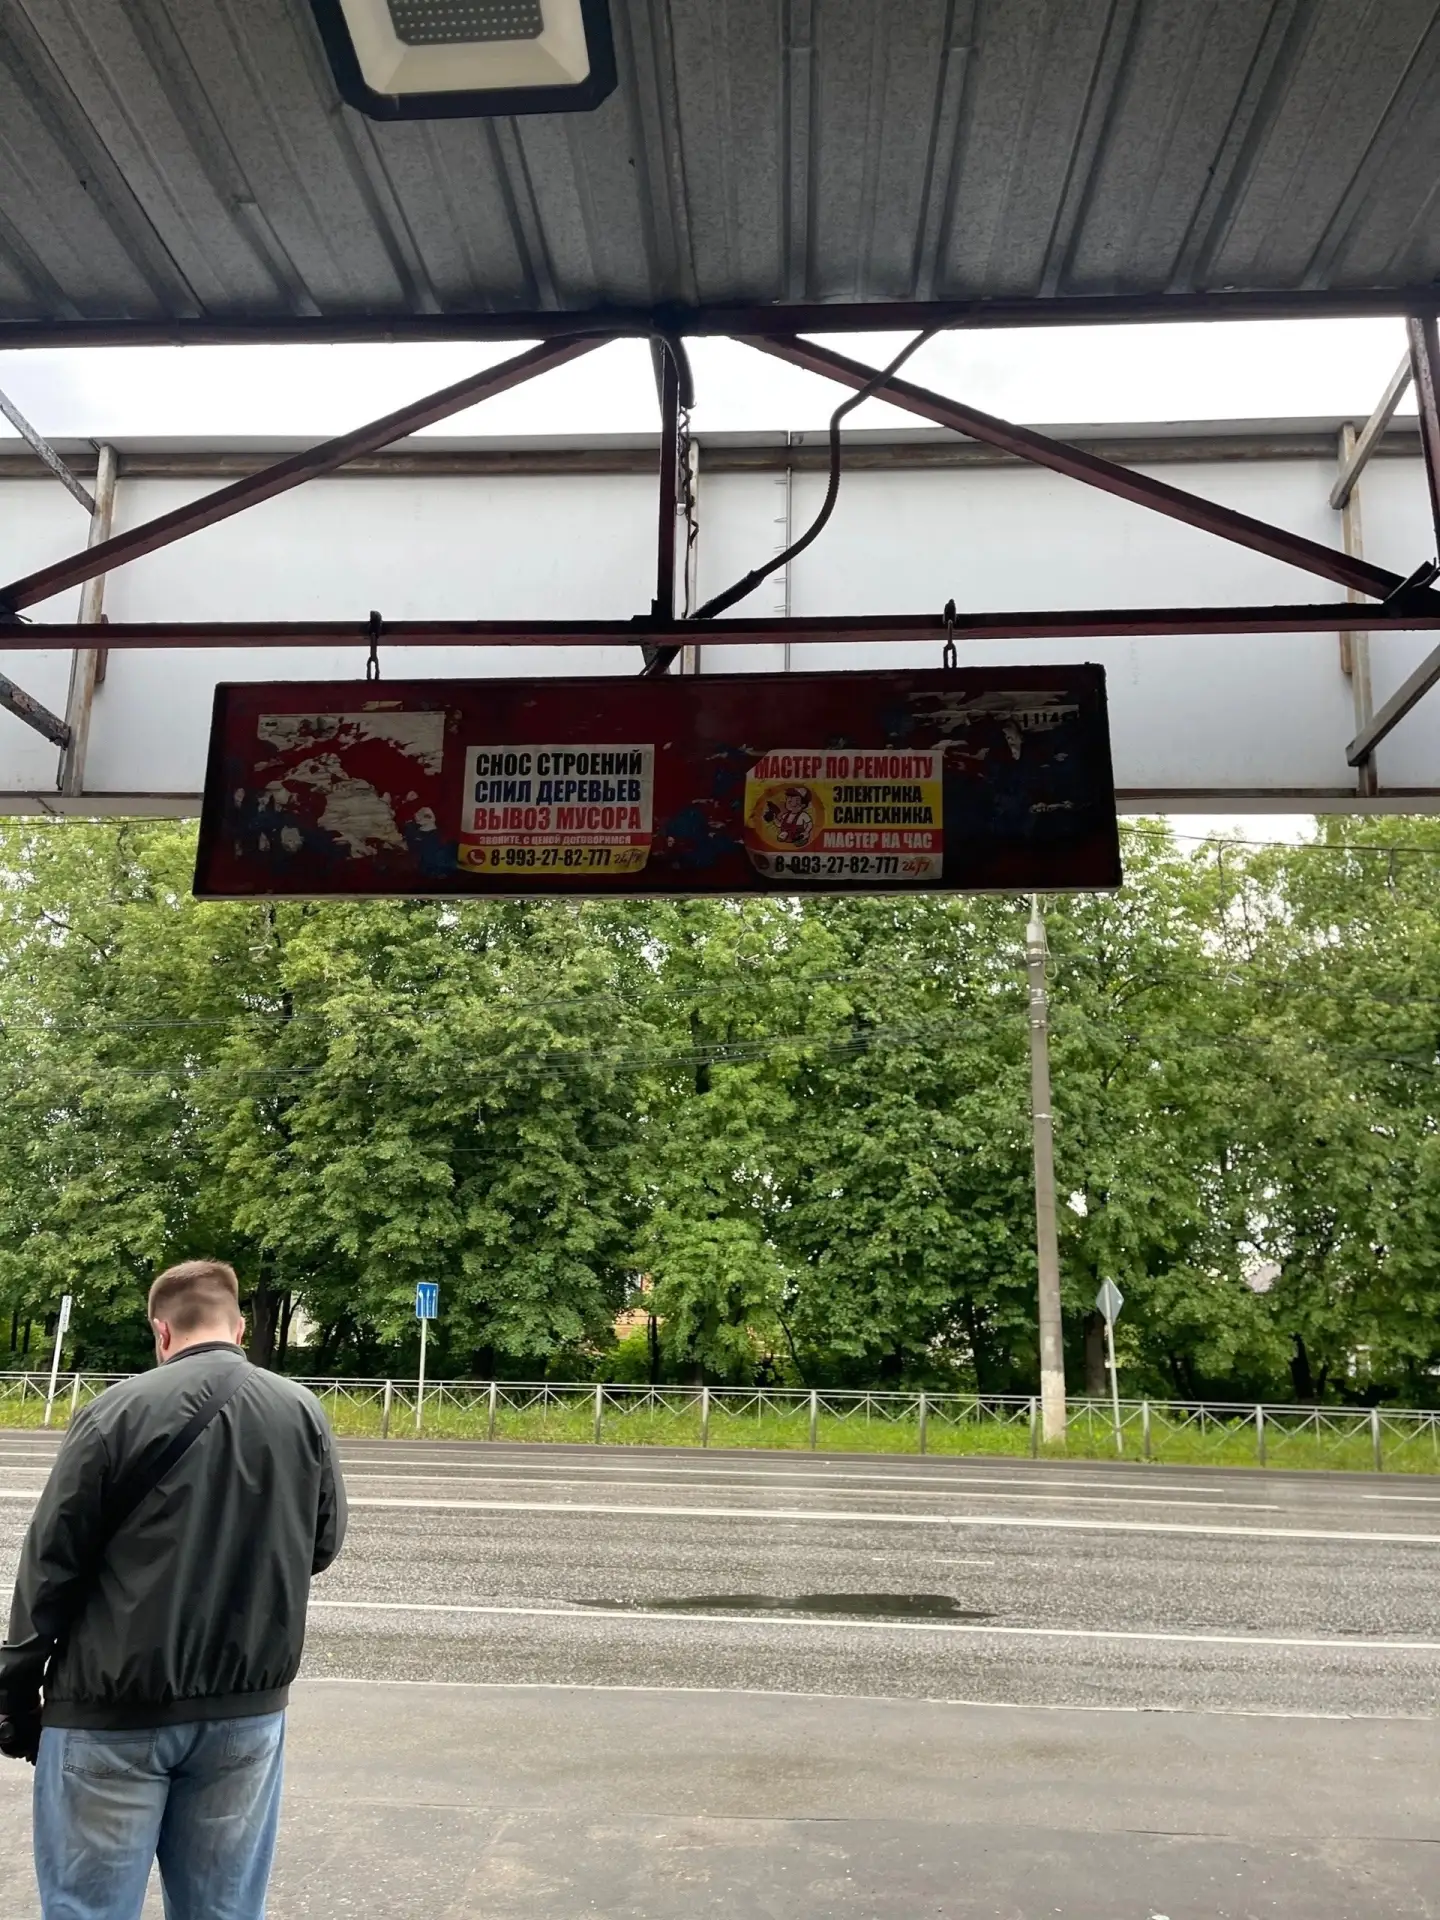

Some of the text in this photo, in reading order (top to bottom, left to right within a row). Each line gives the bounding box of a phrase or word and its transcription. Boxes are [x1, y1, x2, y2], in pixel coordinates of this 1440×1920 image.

[476, 749, 642, 776] СНОС СТРОЕНИЙ
[754, 755, 933, 779] МАСТЕР ПО РЕМОНТУ
[474, 778, 641, 805] СПИЛ ДЕРЕВЬЕВ
[833, 785, 923, 803] ЭЛЕКТРИКА
[473, 806, 642, 830] ВЫВОЗ МУСОРА
[833, 806, 934, 824] САНТЕХНИКА
[523, 835, 530, 845] С
[533, 834, 561, 846] ЦЕНОЙ
[562, 835, 631, 846] ДОГОВОРИМСЯ
[823, 832, 932, 849] МАСТЕР НА ЧАС
[490, 848, 612, 867] 8-993-27-82-777
[902, 860, 932, 877] 24/7
